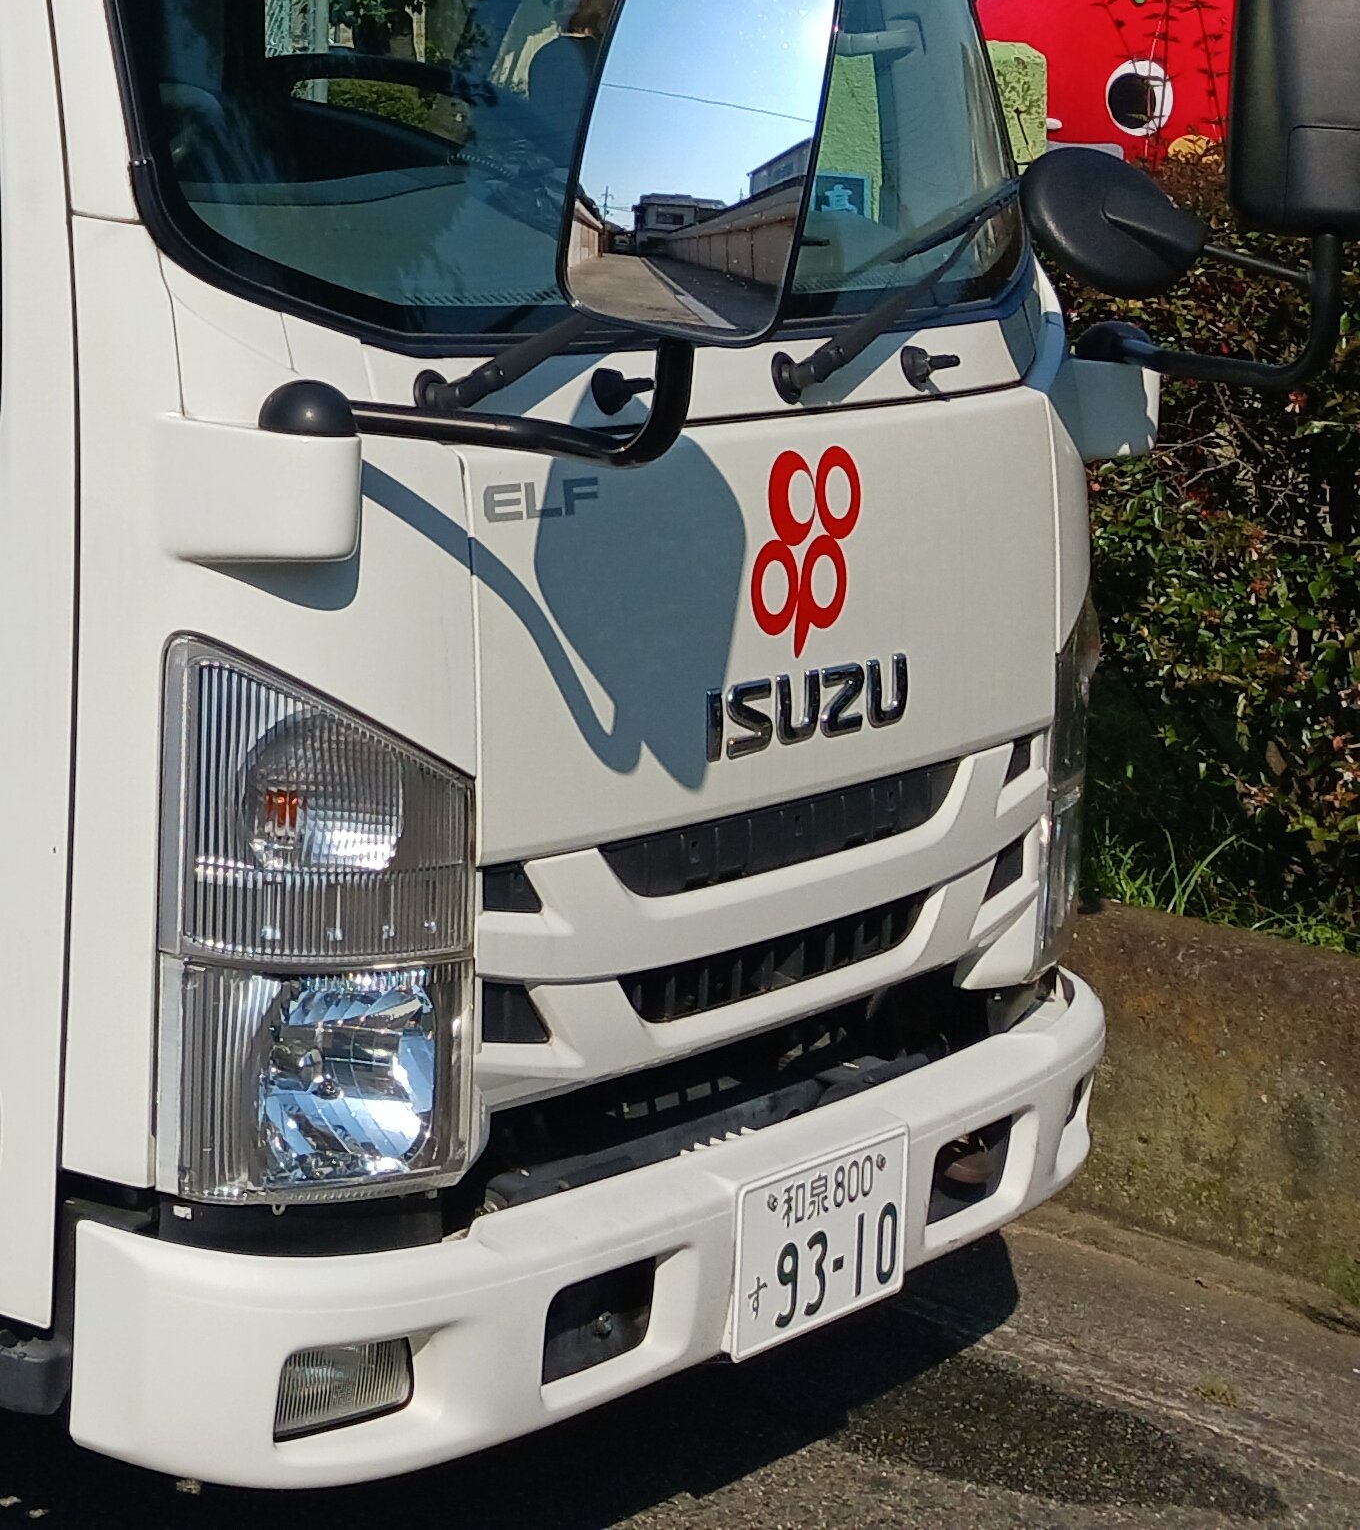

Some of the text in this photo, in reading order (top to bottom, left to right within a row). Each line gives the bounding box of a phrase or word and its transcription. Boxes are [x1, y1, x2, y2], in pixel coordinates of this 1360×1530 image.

[483, 476, 599, 523] ELF
[706, 652, 908, 763] ISUZU
[747, 1201, 898, 1328] す 93-10
